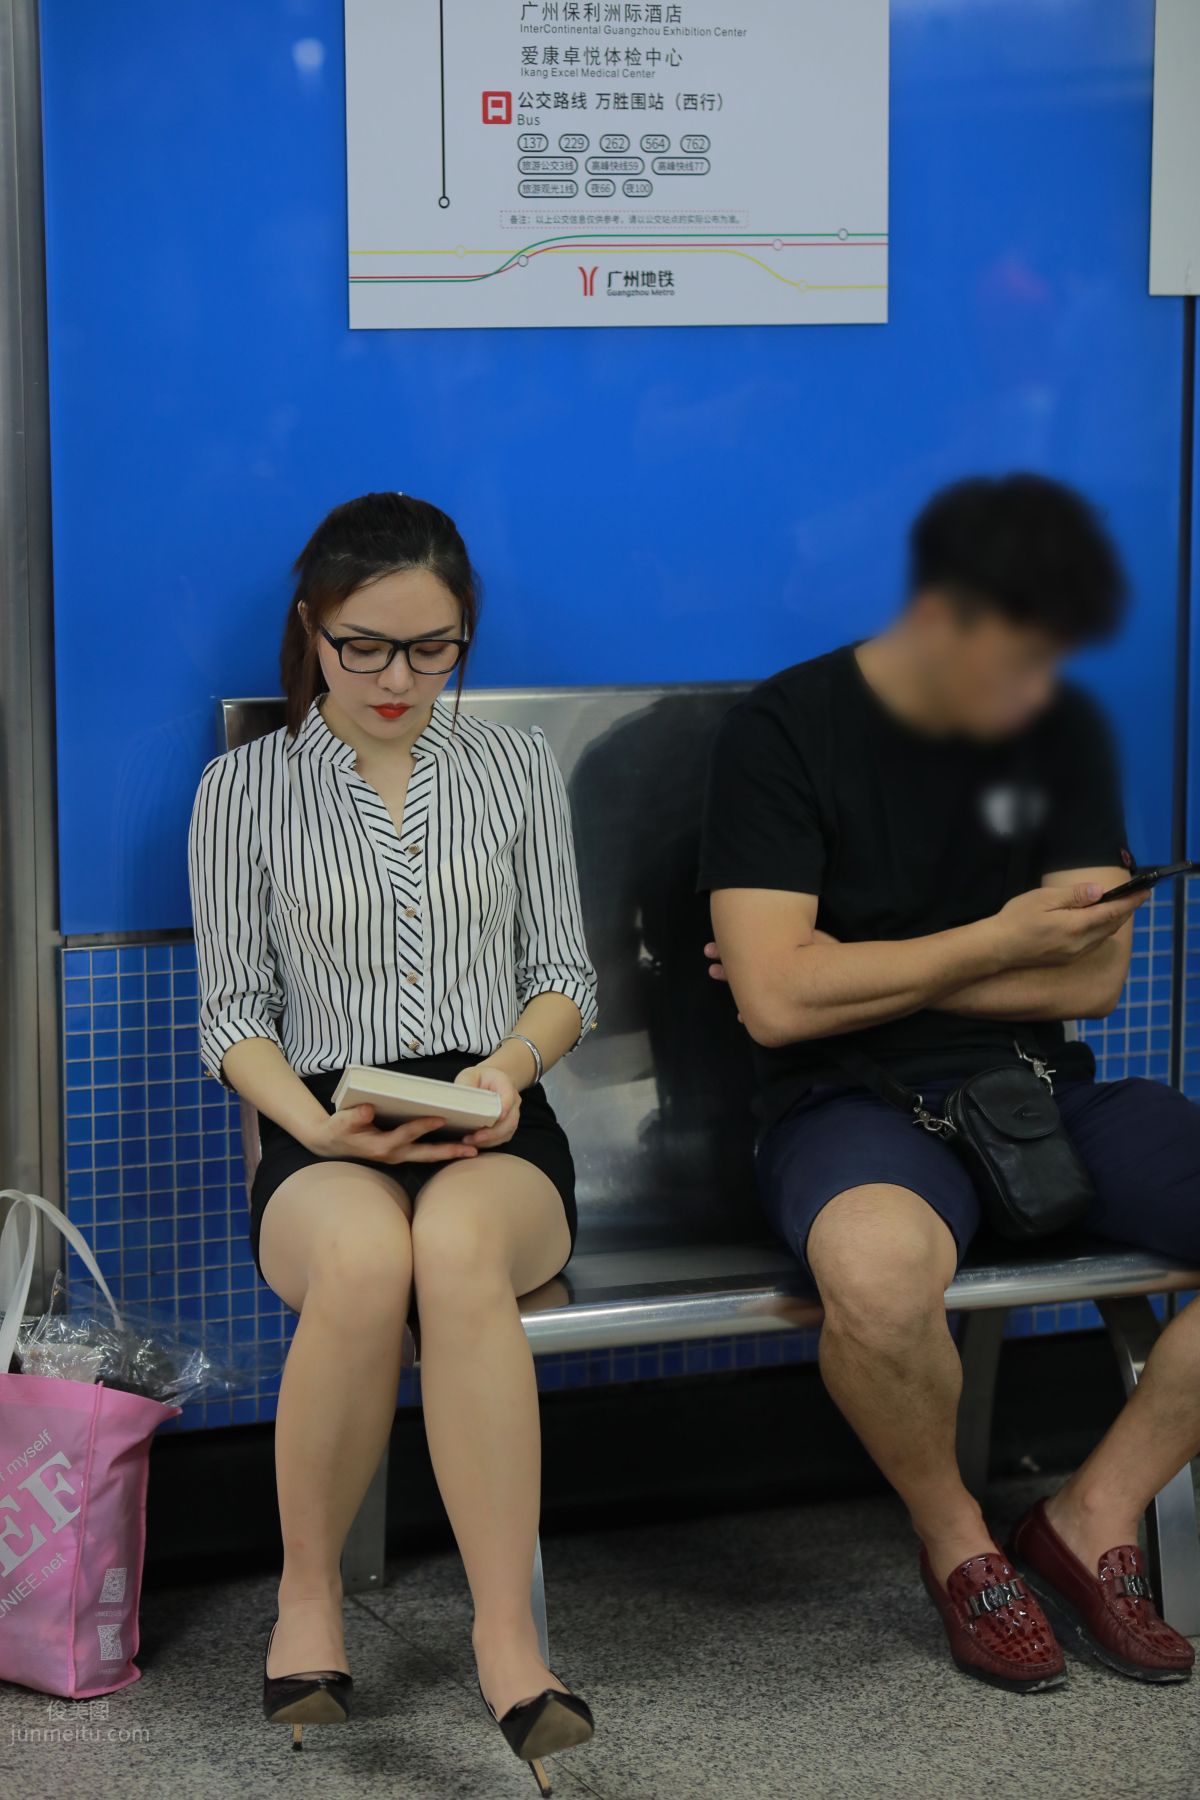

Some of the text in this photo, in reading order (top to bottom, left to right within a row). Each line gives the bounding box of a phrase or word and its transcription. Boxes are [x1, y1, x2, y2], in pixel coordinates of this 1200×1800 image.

[520, 2, 682, 23] 广州保利洲际酒店
[520, 24, 747, 37] InterContinental Guangzhou Exhibition Center
[520, 46, 683, 67] 爱康卓悦体检中心
[520, 68, 656, 79] Ikang Excel Medical Center
[518, 92, 725, 111] 公交路线 万胜围站（西行）
[517, 114, 541, 126] Bus
[523, 137, 706, 150] 137 229 262 564 762
[522, 160, 705, 172] 旅游公交3线 高峰快线59 高峰快线77
[522, 183, 650, 195] 旅游观光1线 夜66 夜100
[607, 270, 675, 288] 广州地铁
[606, 288, 675, 298] Guangzhou Metro
[6, 1428, 52, 1475] myself
